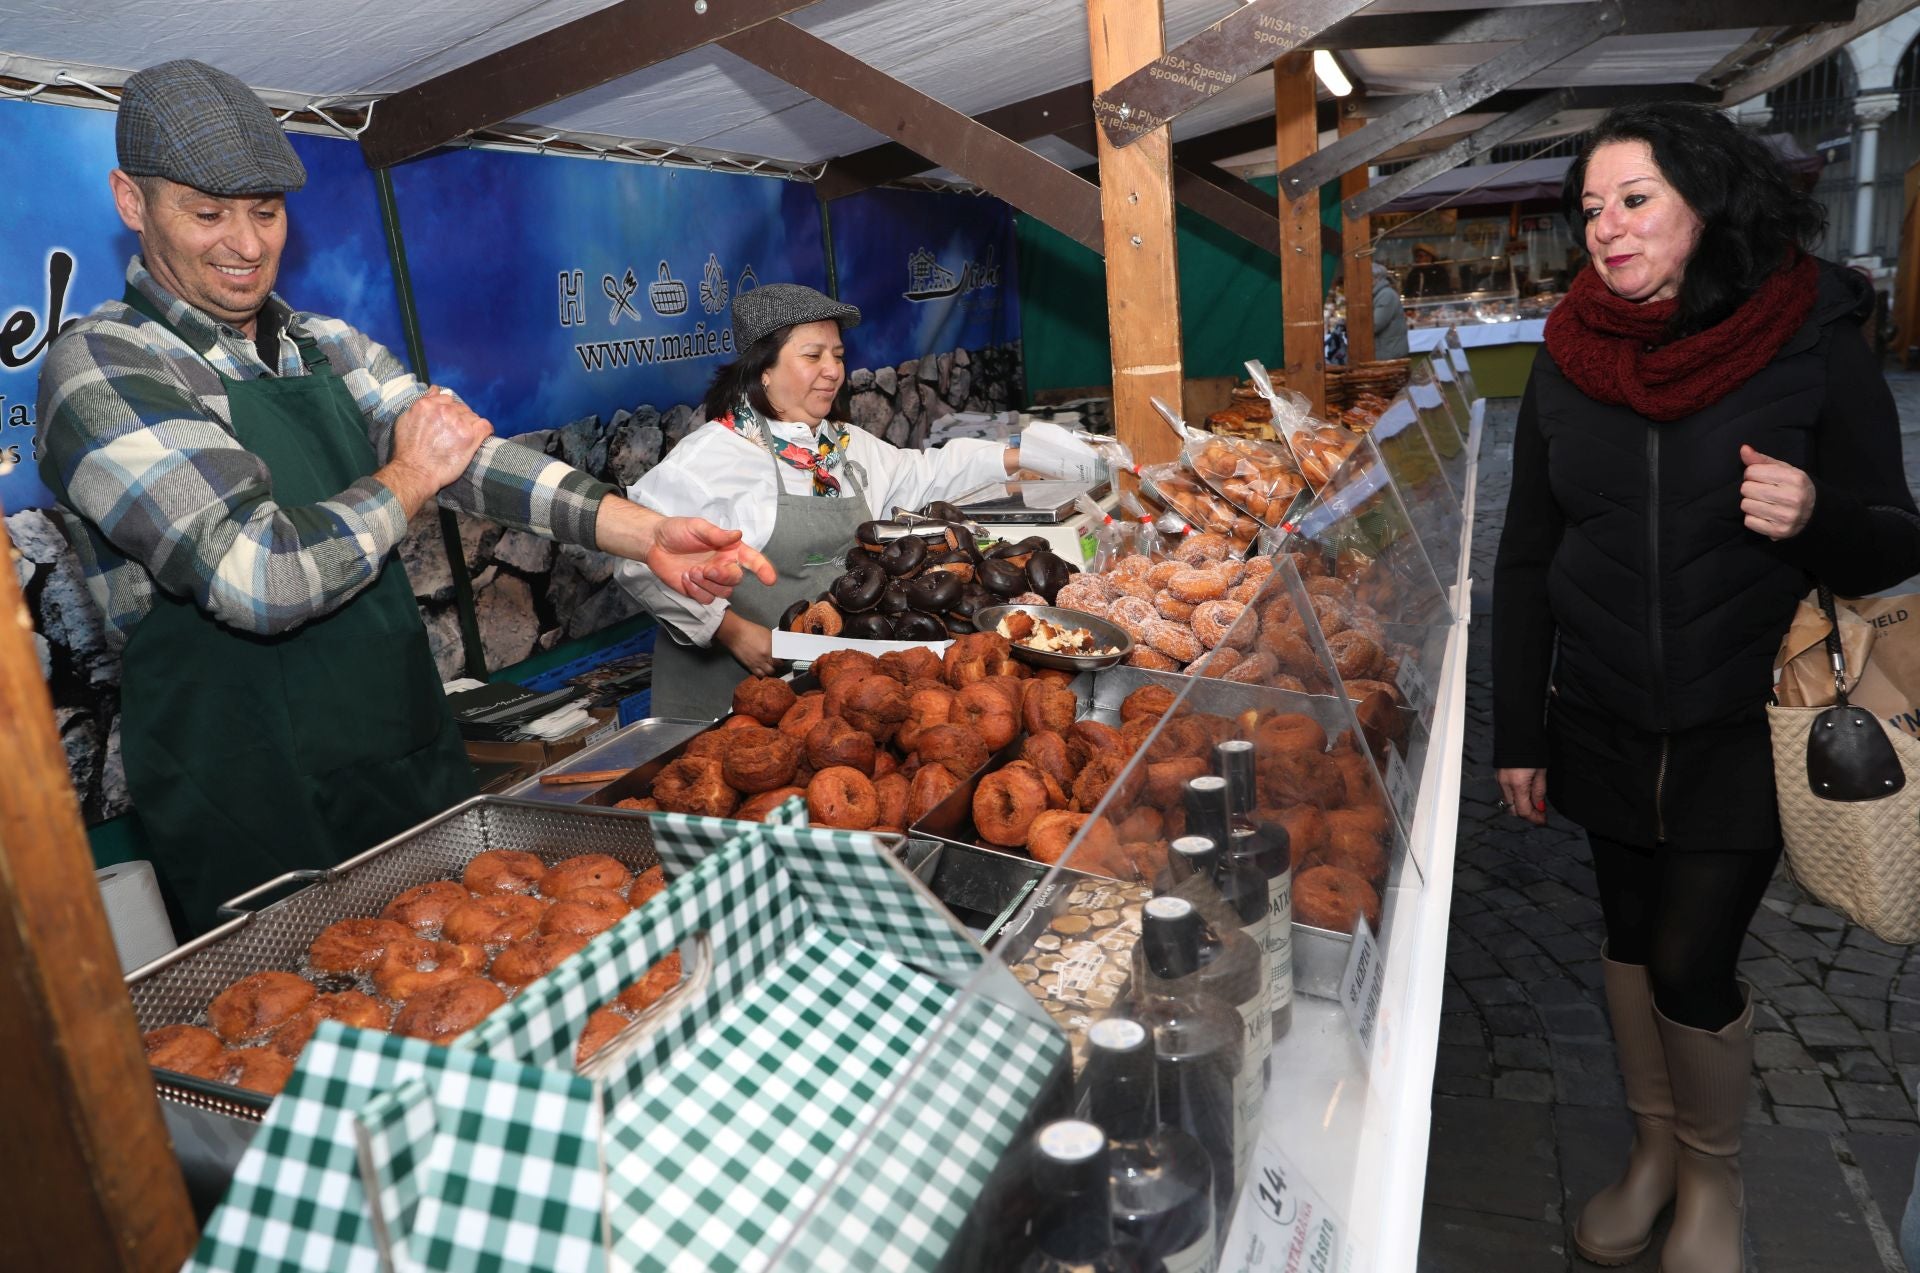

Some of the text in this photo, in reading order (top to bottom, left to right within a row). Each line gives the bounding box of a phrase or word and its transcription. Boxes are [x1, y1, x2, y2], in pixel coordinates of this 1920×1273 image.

[1149, 67, 1206, 93] Plywoods
[1192, 62, 1237, 83] Special
[577, 322, 734, 371] www.mañe.e
[1867, 609, 1908, 629] IELD
